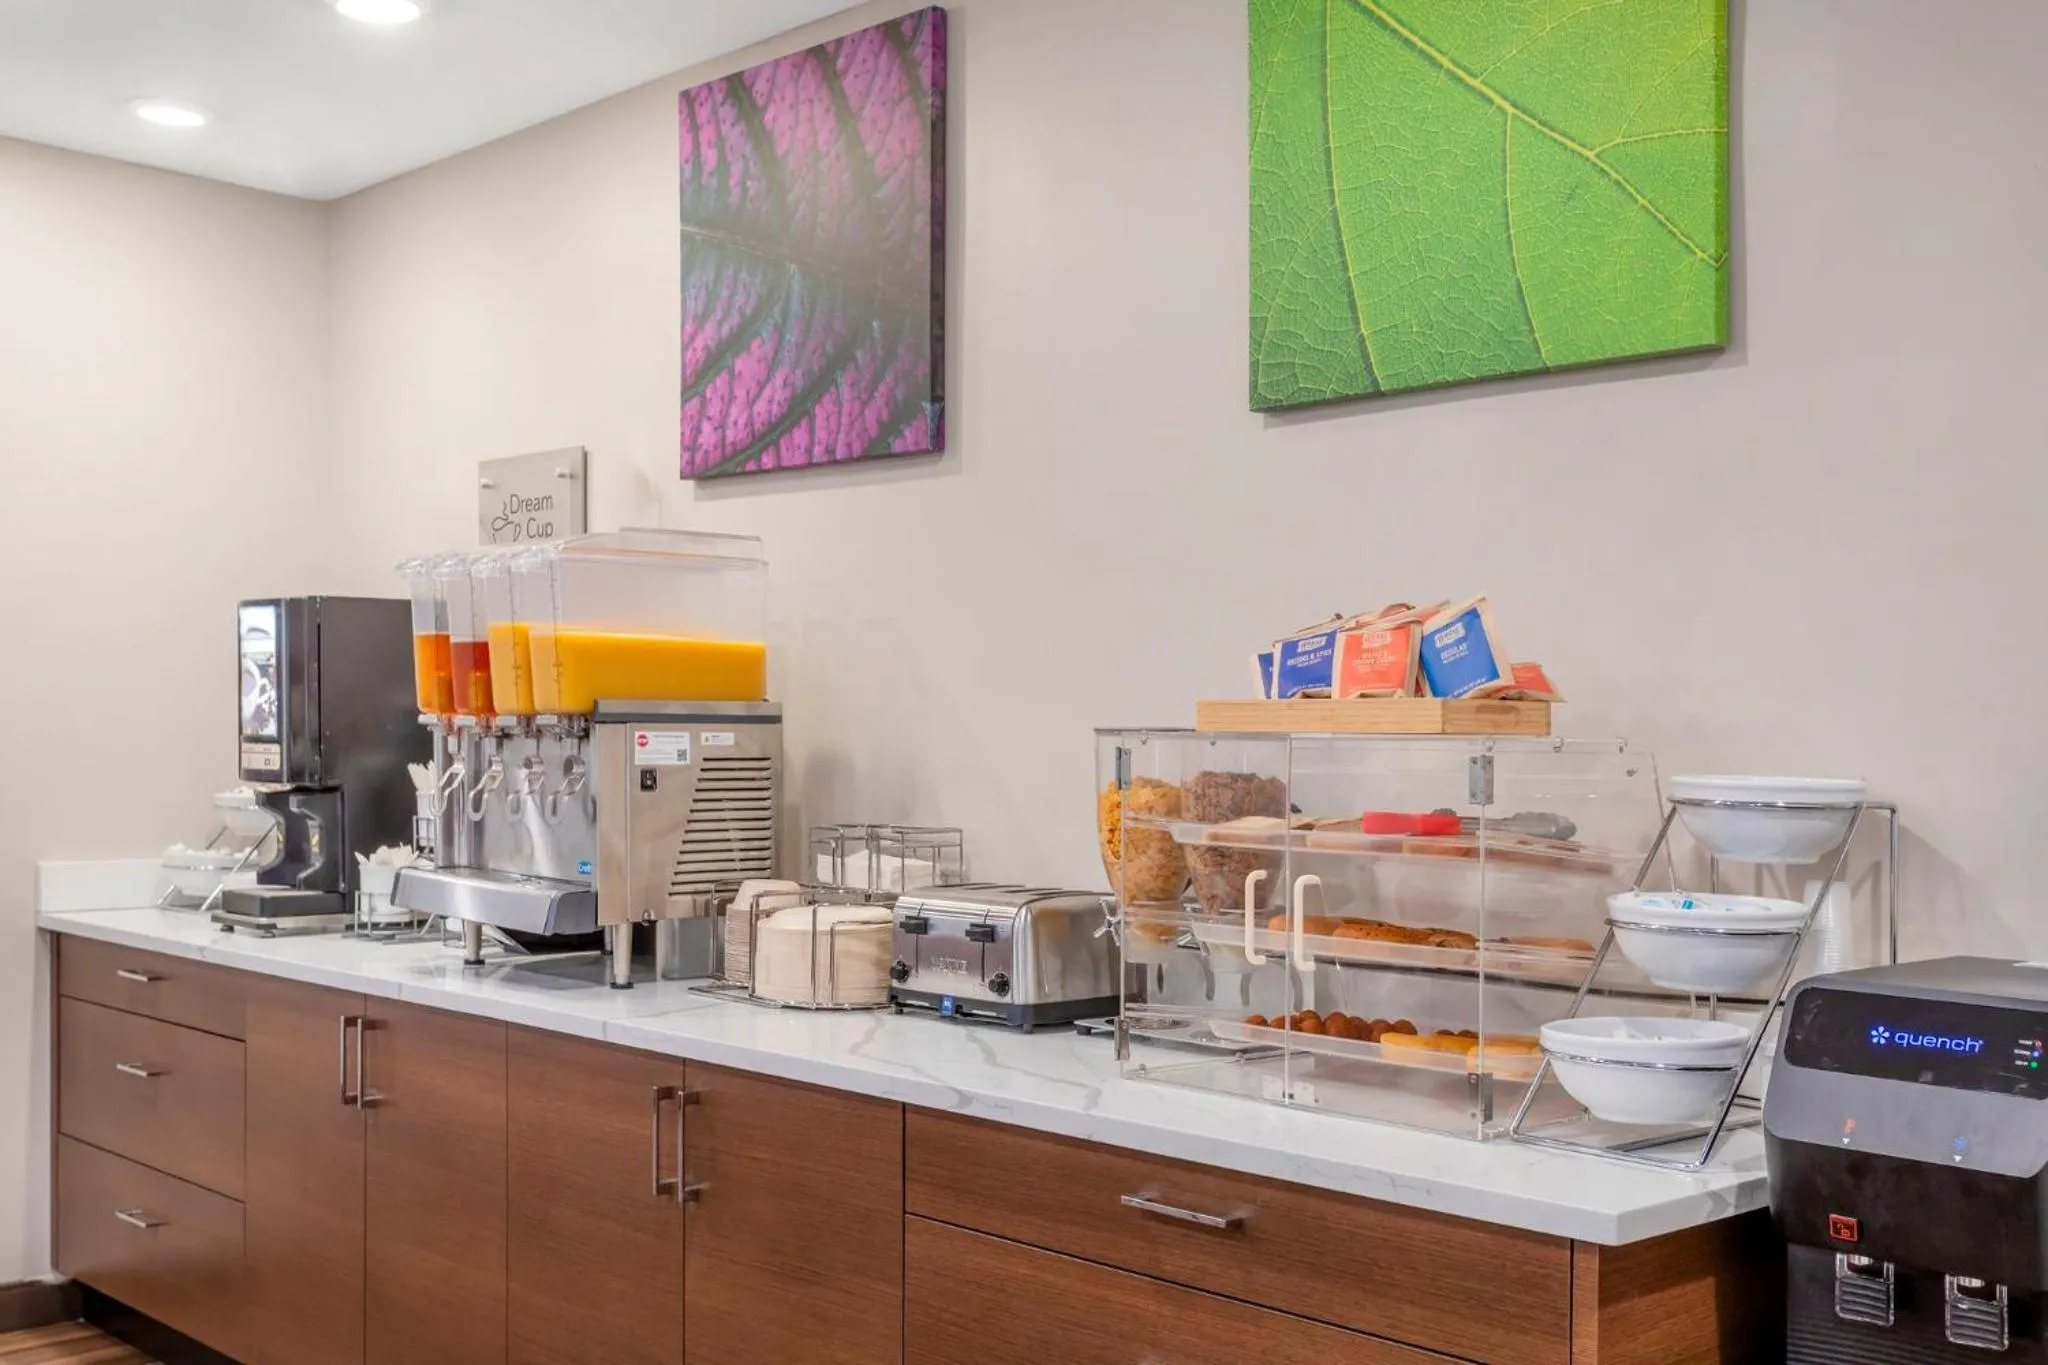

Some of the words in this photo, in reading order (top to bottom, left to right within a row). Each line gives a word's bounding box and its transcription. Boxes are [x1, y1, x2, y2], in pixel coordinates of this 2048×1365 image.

[509, 493, 554, 515] Dream
[526, 517, 554, 539] Cup
[1894, 1032, 1980, 1053] quench
